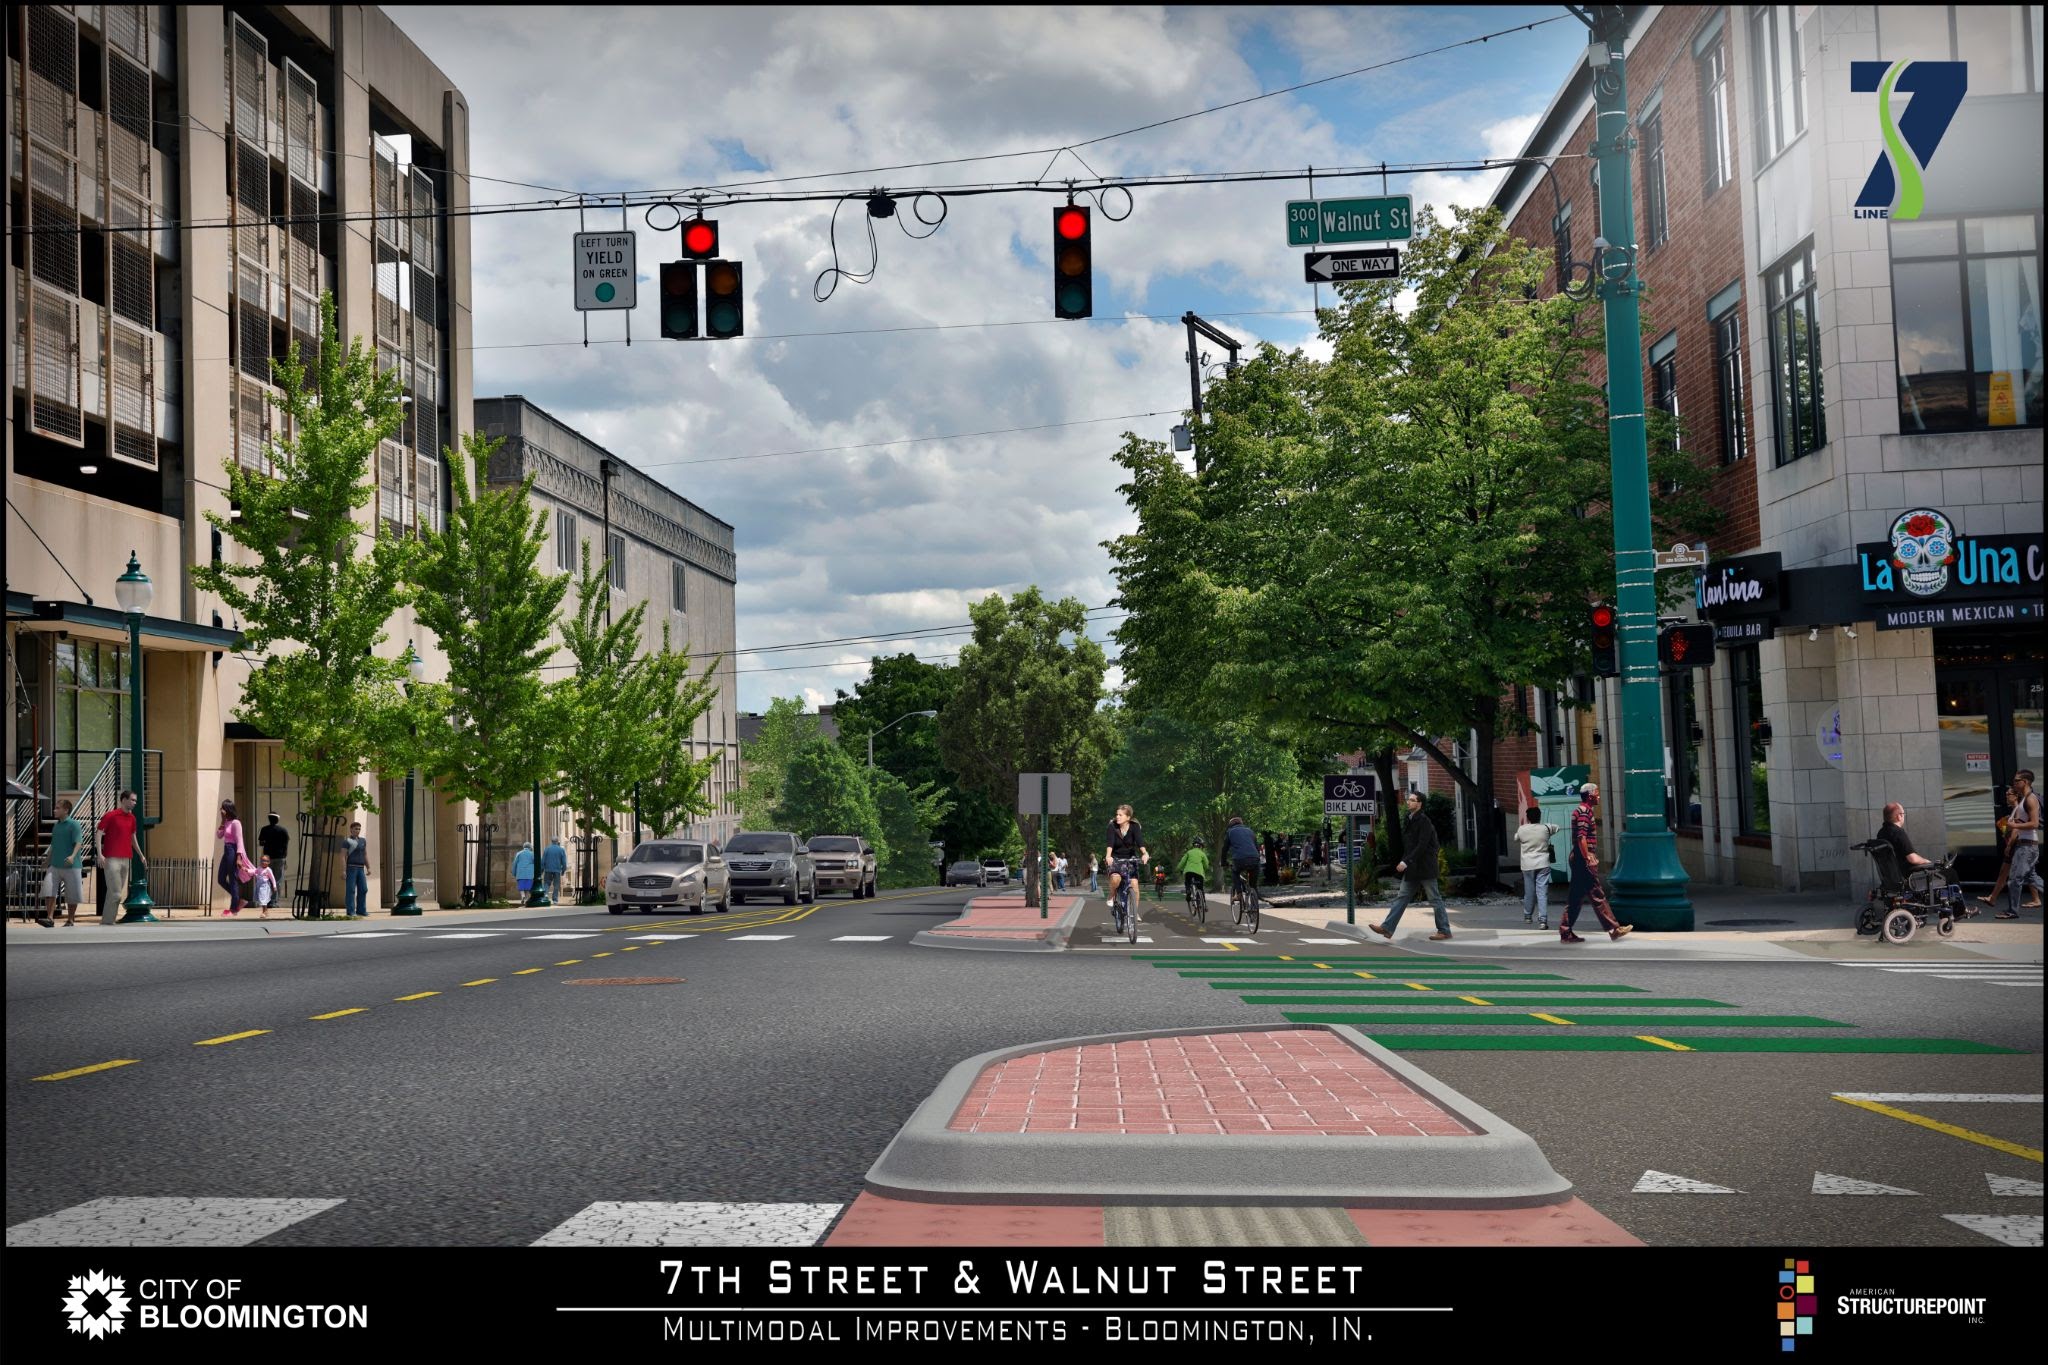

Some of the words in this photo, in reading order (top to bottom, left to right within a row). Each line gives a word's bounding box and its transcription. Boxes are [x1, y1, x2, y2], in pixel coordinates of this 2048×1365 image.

[1290, 208, 1316, 222] 300
[1323, 210, 1380, 232] Walnut
[1390, 207, 1408, 229] St
[1300, 226, 1309, 239] N
[581, 239, 601, 247] LEFT
[605, 237, 628, 247] TURN
[586, 251, 623, 264] YIELD
[1332, 260, 1358, 272] ONE
[1361, 258, 1389, 271] WAY
[583, 269, 595, 278] ON
[599, 269, 628, 278] GREEN
[1860, 553, 1894, 592] La
[1957, 540, 2020, 586] Una
[2026, 544, 2044, 582] C
[1702, 567, 1763, 608] Cantina
[1887, 610, 1945, 626] MODERN
[1952, 605, 2015, 621] MEXICAN
[1746, 623, 1761, 636] BAR
[2030, 684, 2044, 693] 25
[1326, 802, 1347, 812] BIKE
[1350, 802, 1373, 812] LANE
